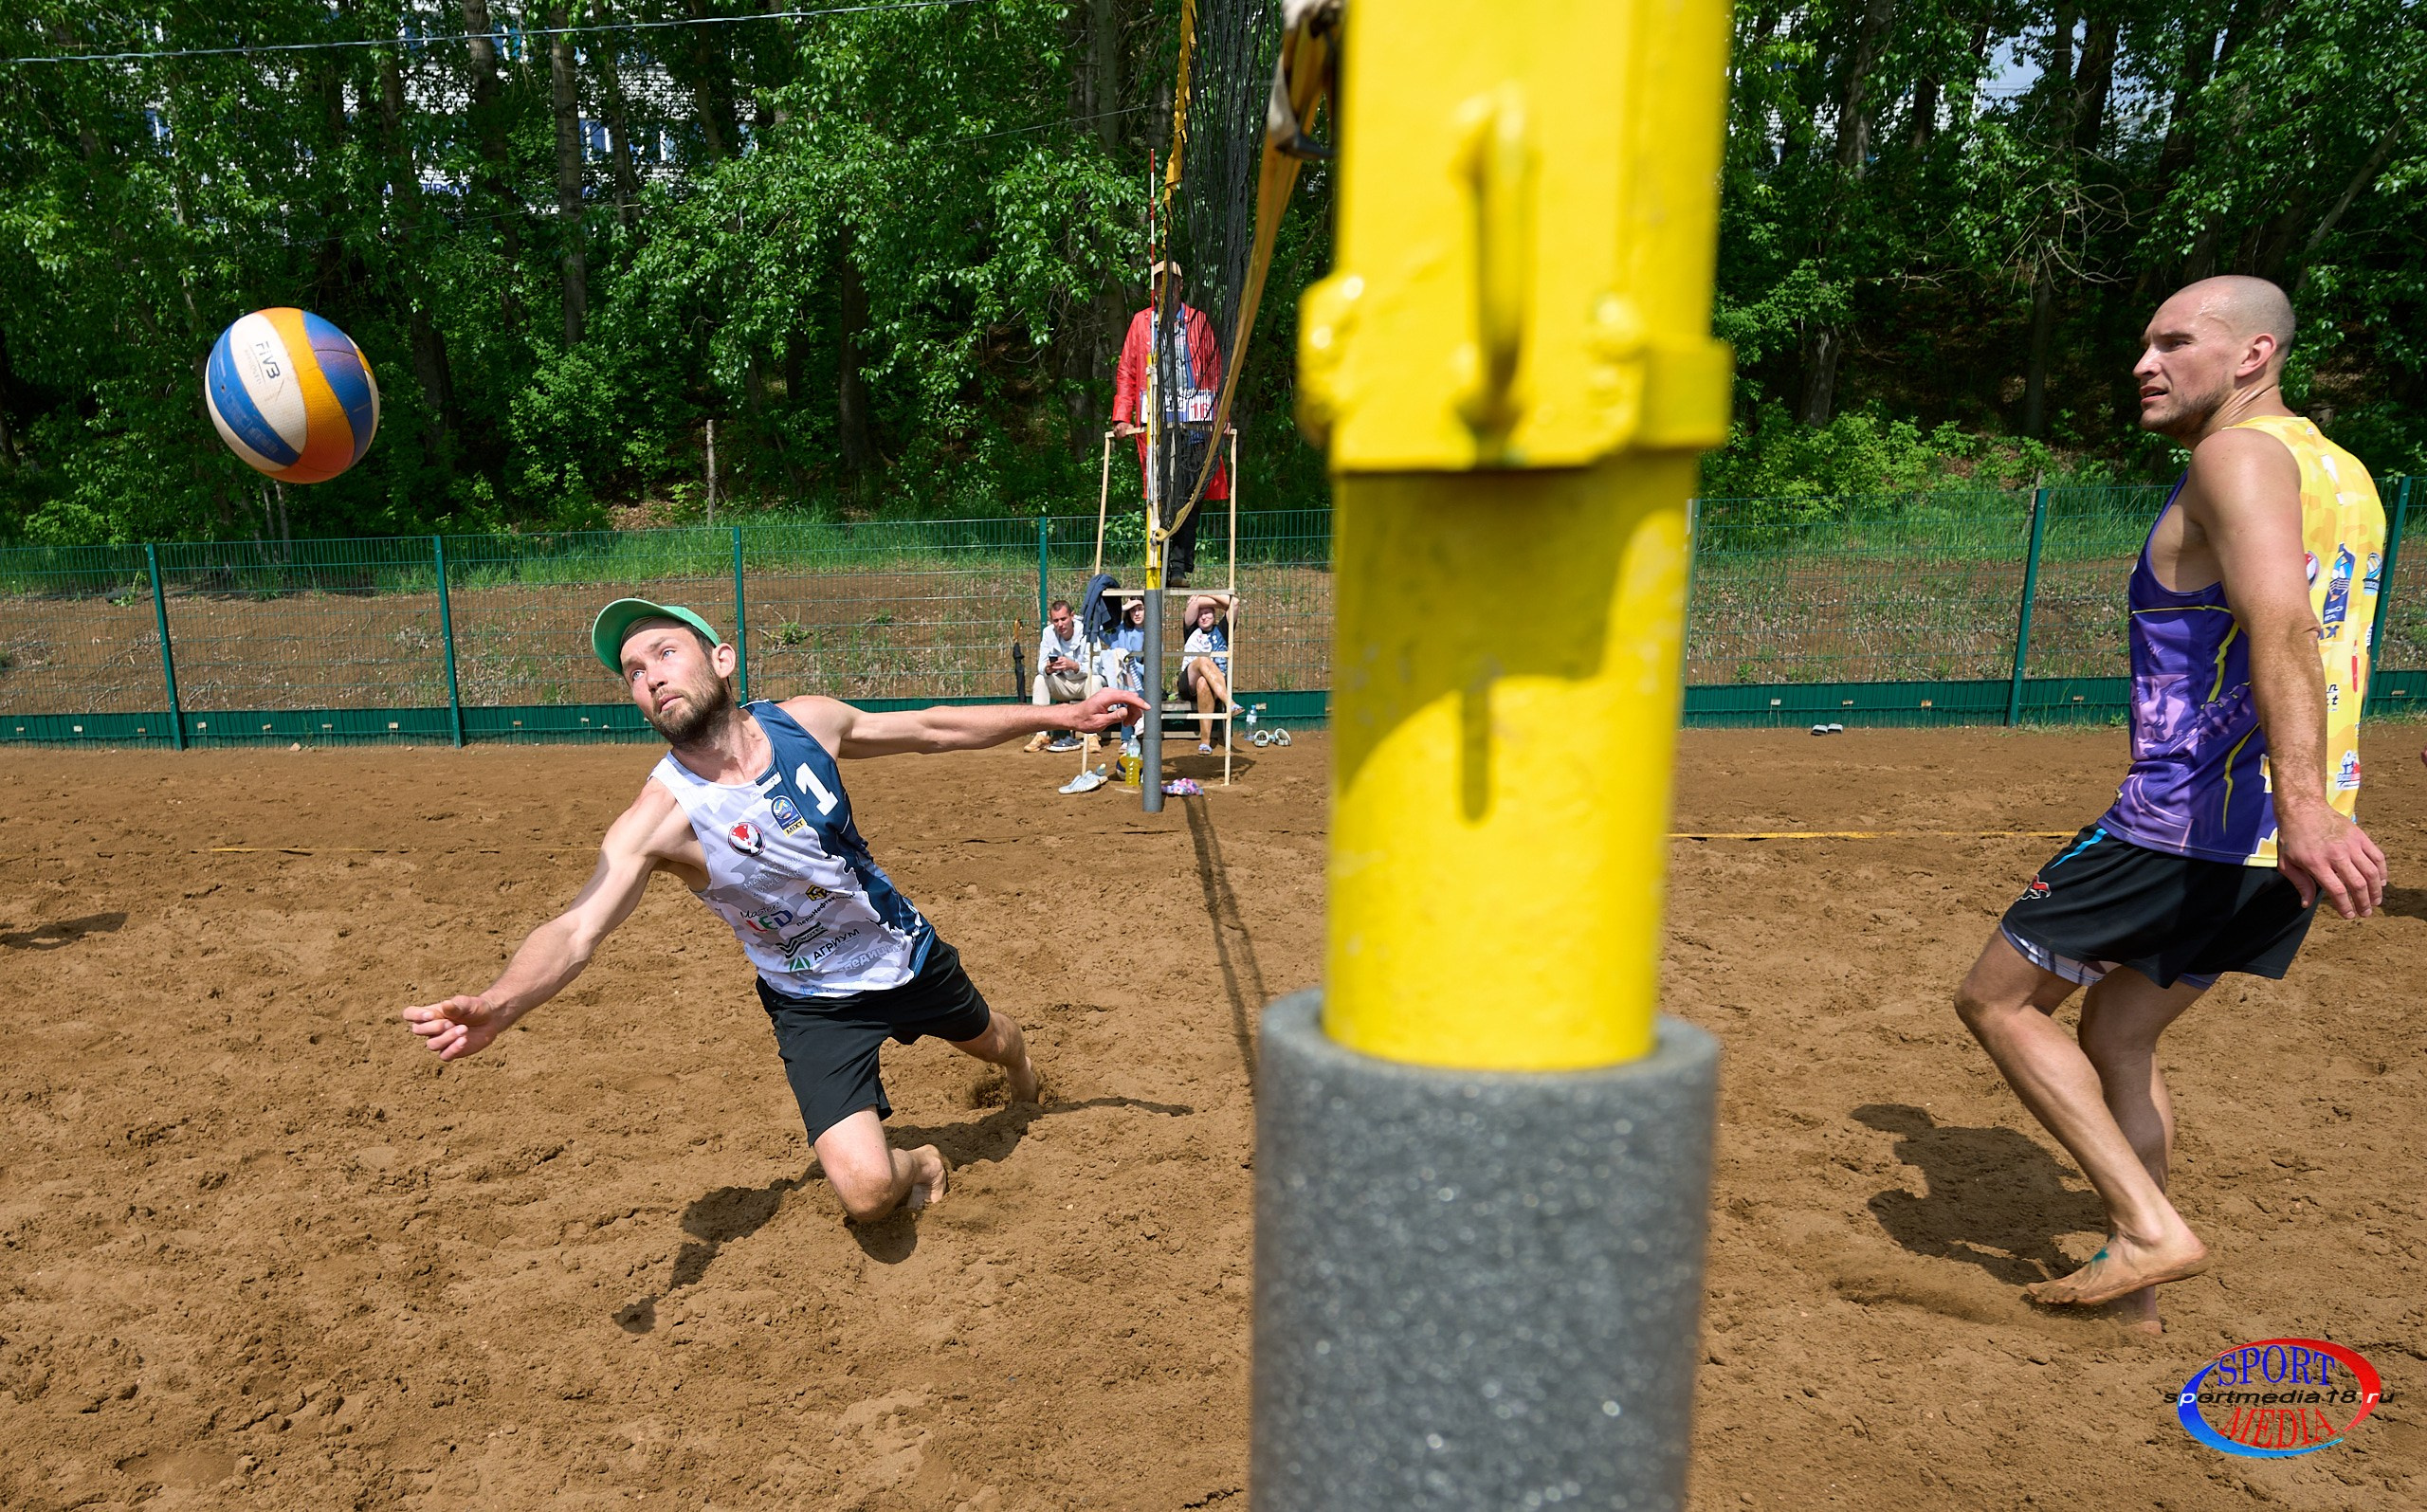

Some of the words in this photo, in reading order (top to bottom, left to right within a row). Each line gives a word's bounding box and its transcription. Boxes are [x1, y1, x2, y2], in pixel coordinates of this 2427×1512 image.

[795, 762, 838, 816] 1
[786, 819, 804, 835] MIXT
[759, 868, 803, 893] ИЖЕСК
[746, 910, 794, 933] LED
[813, 928, 861, 961] АГРИУМ
